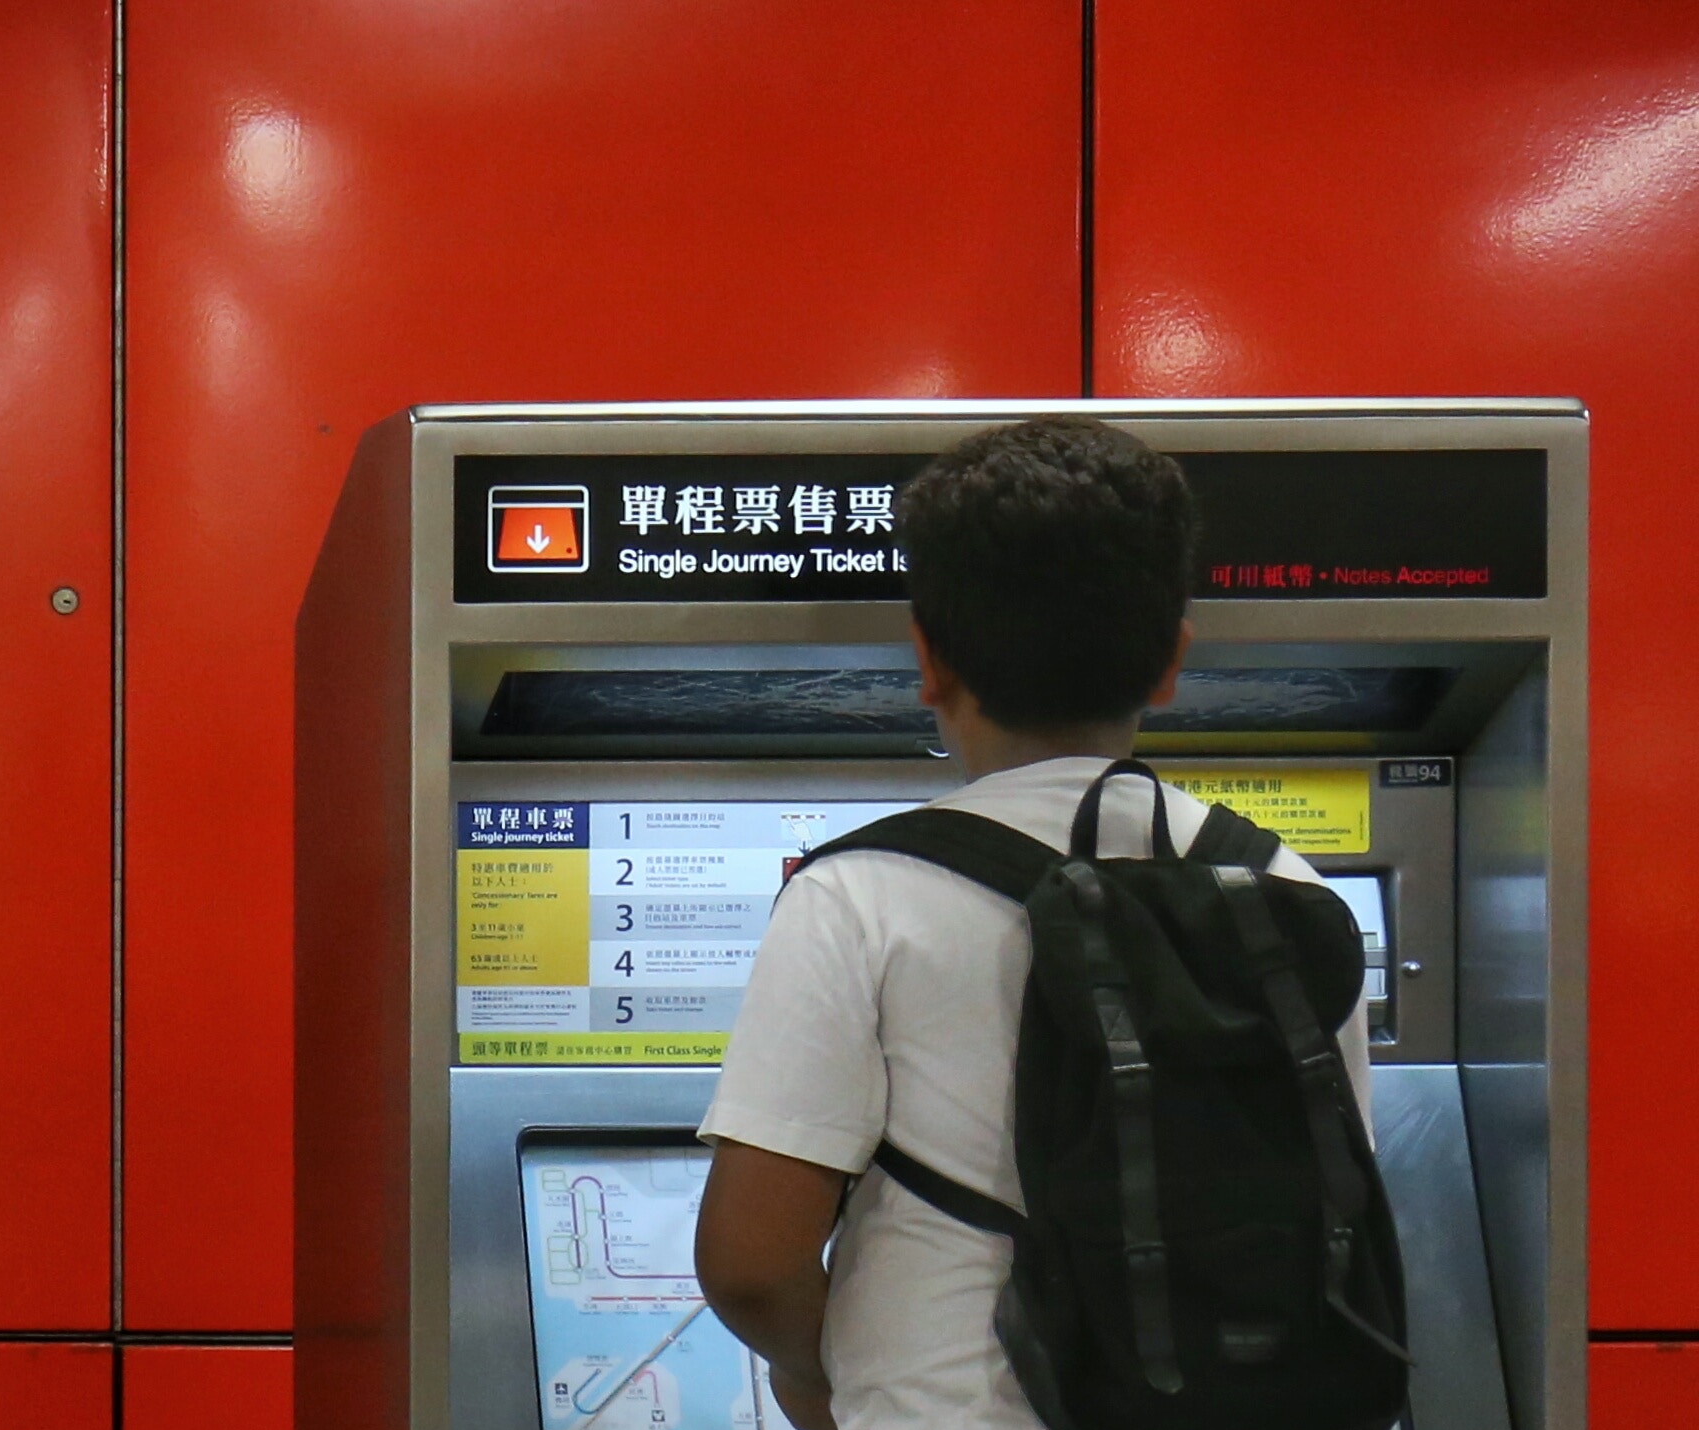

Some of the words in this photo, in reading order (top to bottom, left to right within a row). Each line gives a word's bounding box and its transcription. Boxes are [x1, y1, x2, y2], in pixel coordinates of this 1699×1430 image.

[619, 484, 896, 535] 單程票售票
[618, 548, 698, 578] Single
[703, 548, 805, 578] Journey
[809, 548, 885, 575] Ticket
[1211, 564, 1313, 588] 可用紙幣
[1333, 566, 1392, 584] Notes
[1396, 566, 1490, 588] Accepted
[1418, 766, 1441, 782] 94
[1172, 779, 1283, 794] 港元紙幣適用
[471, 806, 575, 830] 單程車票
[618, 812, 631, 840] 1
[1294, 827, 1352, 836] denominations
[471, 831, 504, 845] Single
[504, 831, 545, 845] journey
[545, 831, 575, 843] ticket
[1302, 838, 1341, 846] respectively
[615, 858, 635, 886] 2
[471, 902, 488, 910] only
[615, 904, 634, 932] 3
[614, 950, 635, 978] 4
[615, 996, 634, 1024] 5
[472, 1041, 549, 1057] 頭等單程票
[644, 1045, 666, 1056] First
[666, 1045, 691, 1056] Class
[692, 1045, 722, 1057] Single
